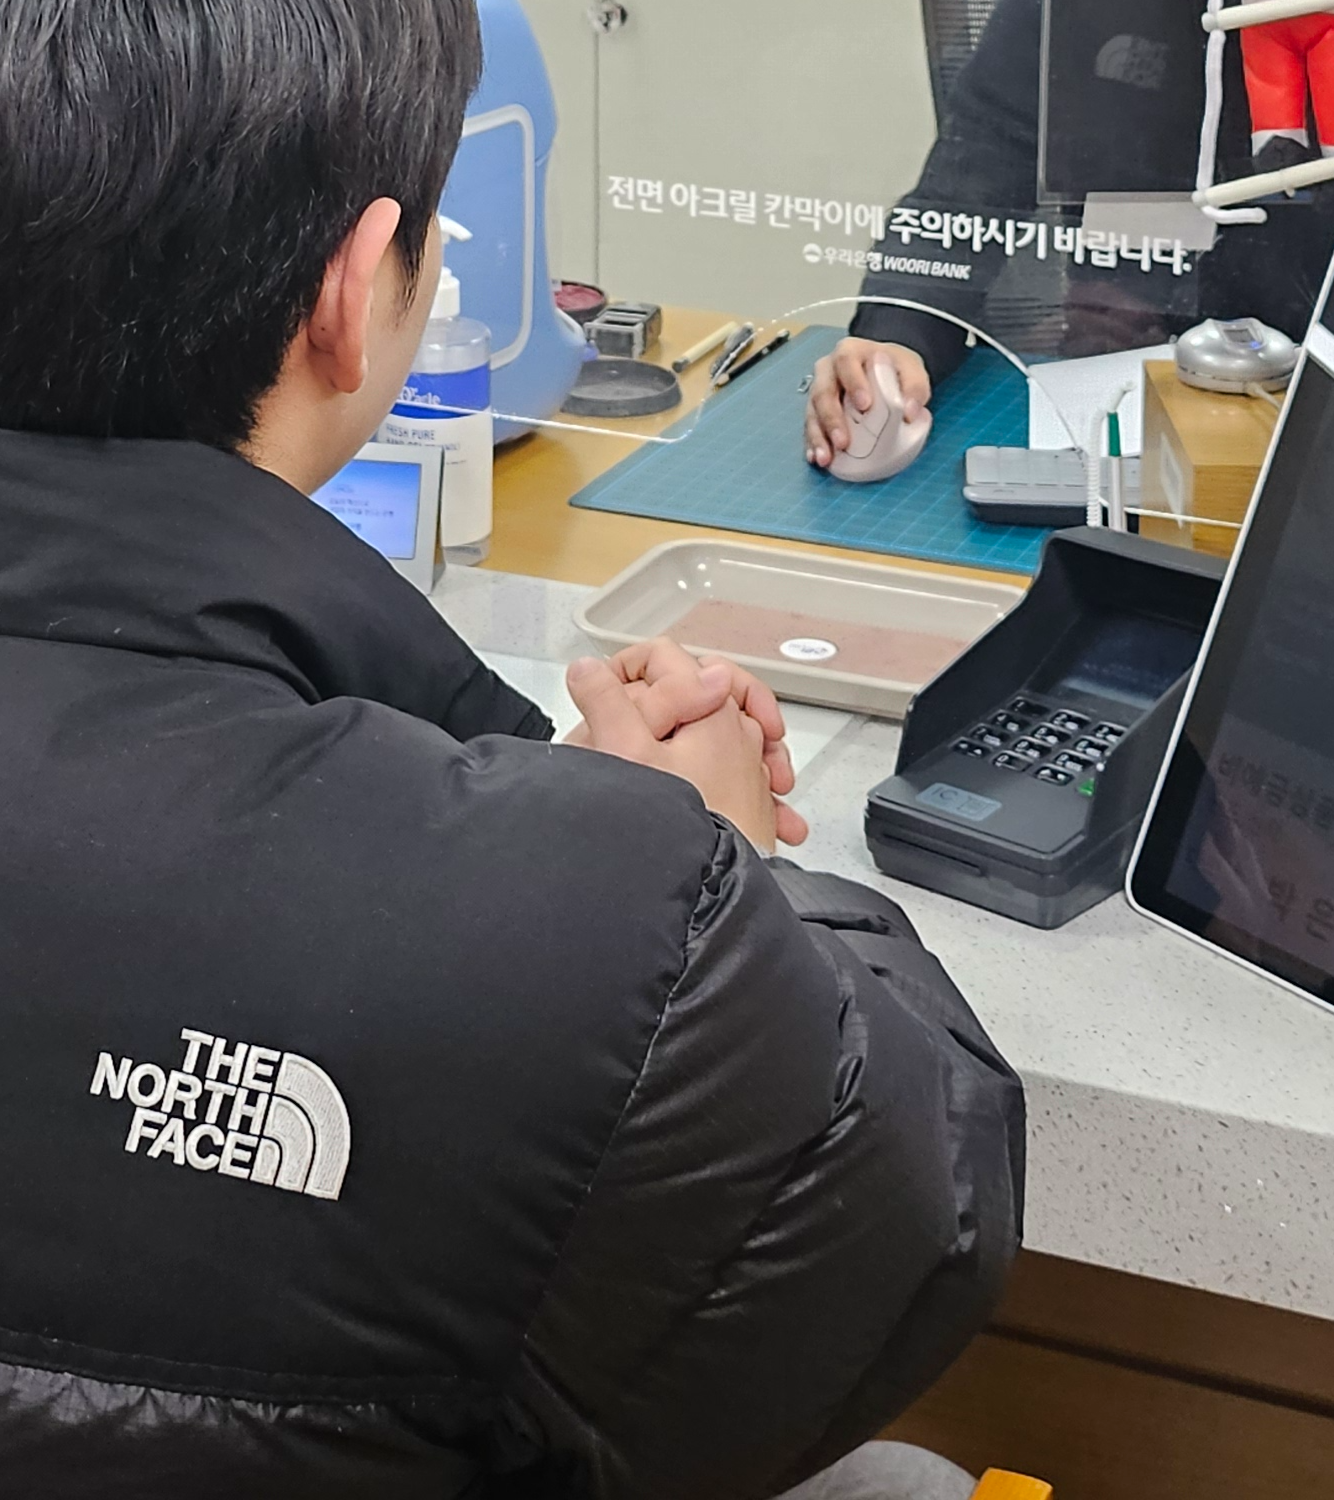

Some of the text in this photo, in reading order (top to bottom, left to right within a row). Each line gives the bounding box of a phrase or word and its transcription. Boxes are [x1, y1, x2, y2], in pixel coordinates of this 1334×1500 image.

[607, 175, 1193, 277] 전면 아크릴 칸막이에 주의하시기 바랍니다.
[824, 246, 971, 280] 우리은행 WOORI BANK
[386, 423, 435, 441] FRESH PURE
[90, 1052, 269, 1136] NORTH
[181, 1027, 281, 1094] THE
[124, 1106, 260, 1180] FACE
